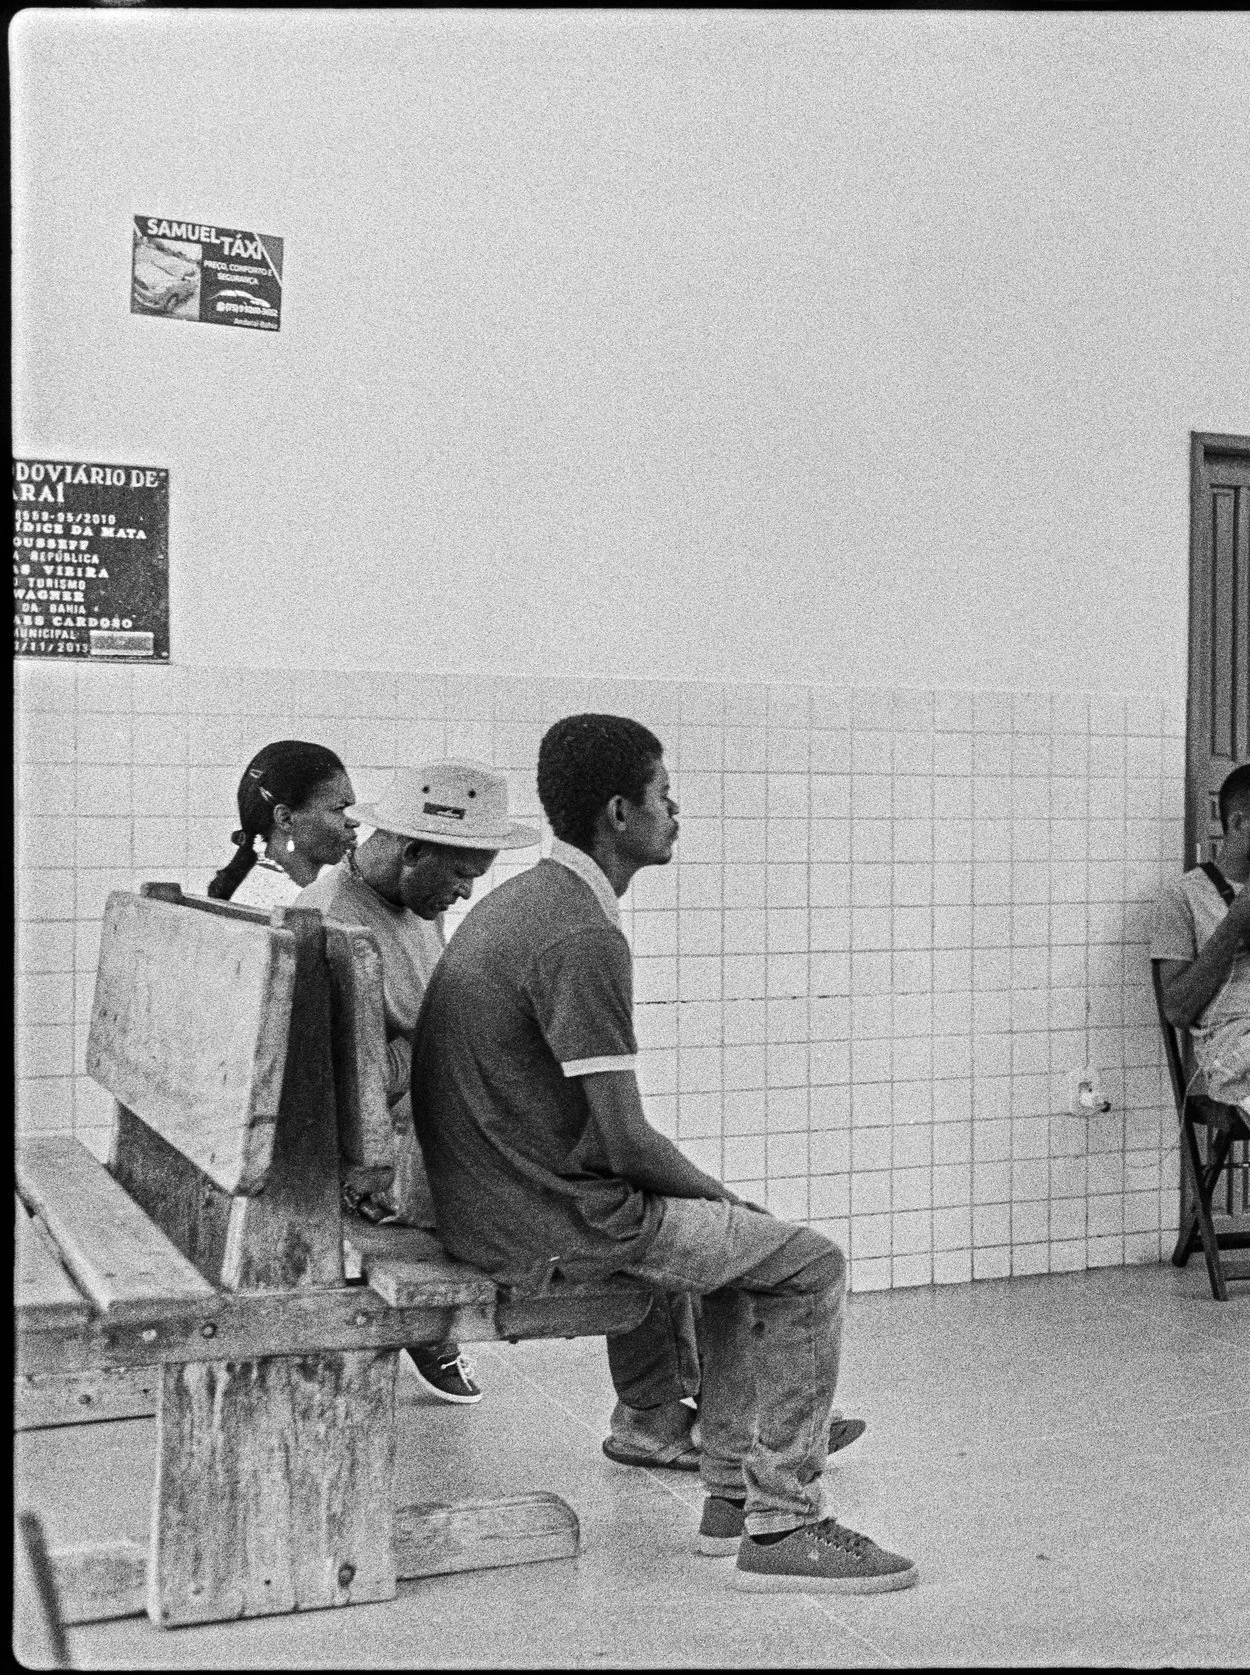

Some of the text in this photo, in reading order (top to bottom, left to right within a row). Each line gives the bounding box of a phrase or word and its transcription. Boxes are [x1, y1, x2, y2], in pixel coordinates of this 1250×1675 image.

[147, 218, 221, 244] SAMUEL
[219, 233, 263, 260] TÁXI
[14, 462, 158, 488] DOVIÁRIO DE
[70, 524, 94, 536] DA
[101, 526, 147, 539] MATA
[30, 550, 99, 564] REPÚBLICA
[43, 565, 109, 578] VIEIRA
[28, 577, 86, 590] TURISMO
[14, 589, 85, 602] WAGNER
[50, 603, 86, 614] BAHIA
[52, 616, 133, 629] CARDOSO
